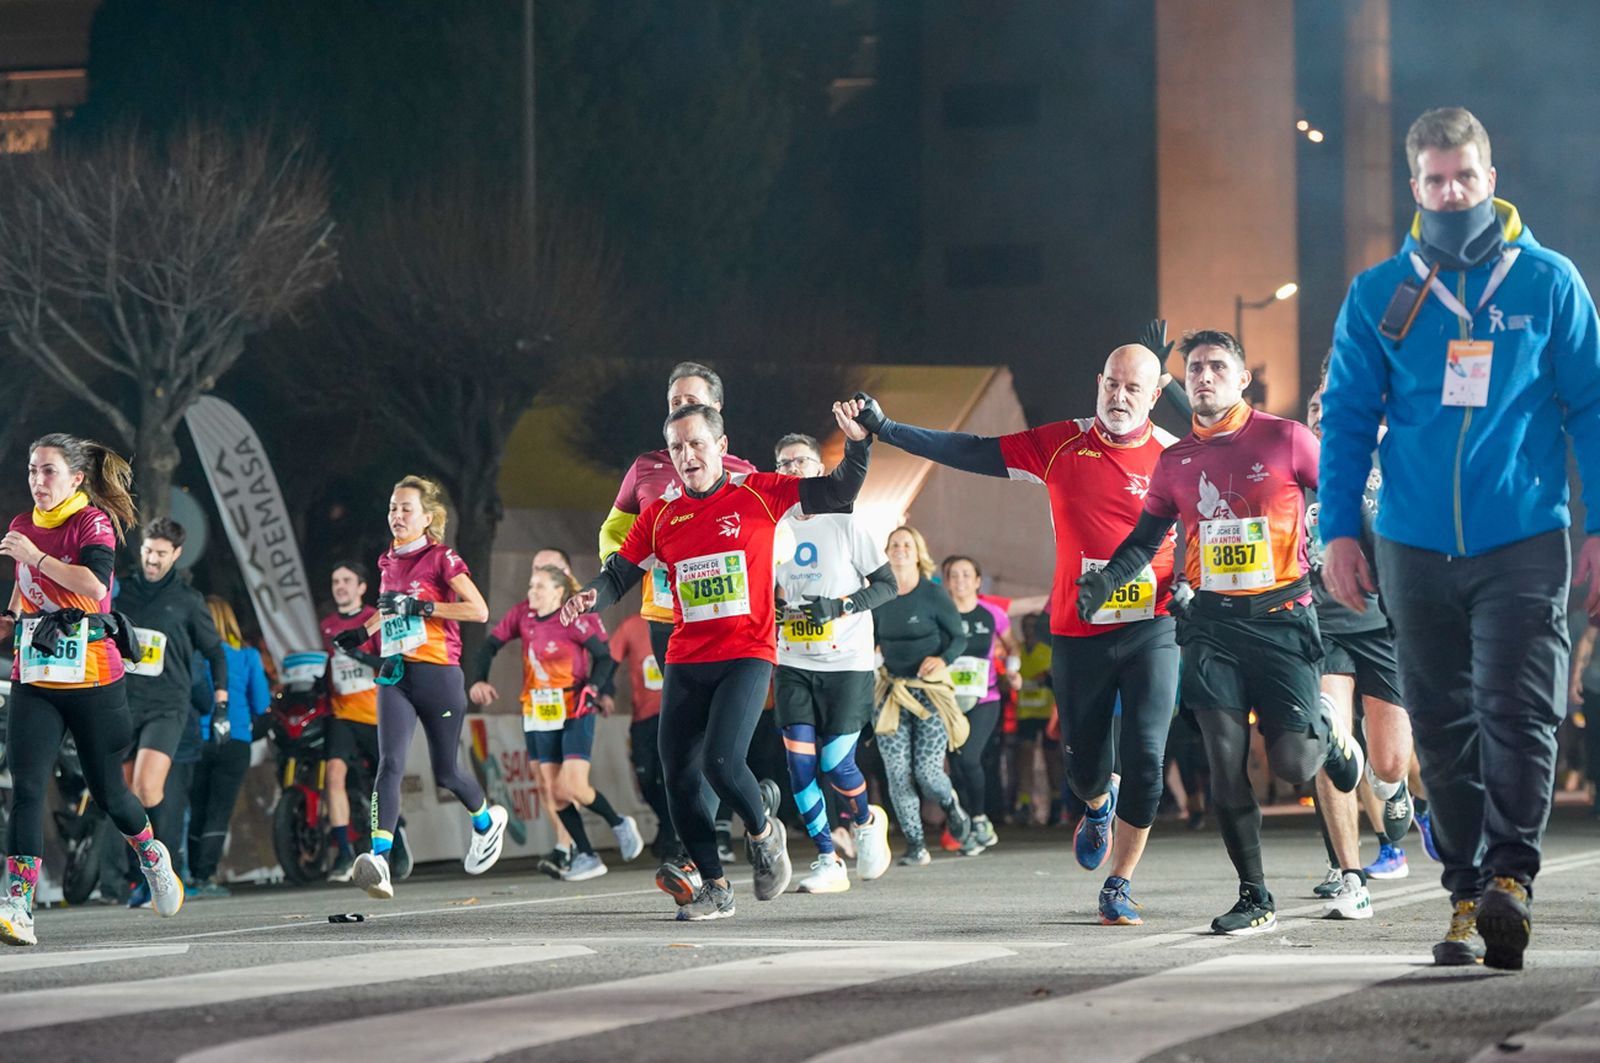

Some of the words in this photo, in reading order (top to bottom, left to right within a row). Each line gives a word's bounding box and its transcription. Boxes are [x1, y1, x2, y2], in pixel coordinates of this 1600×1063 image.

[235, 435, 308, 602] JAPEMASA
[689, 563, 709, 572] NOCHE
[711, 560, 719, 569] DE
[1212, 543, 1256, 566] 3857
[692, 575, 733, 599] 7831
